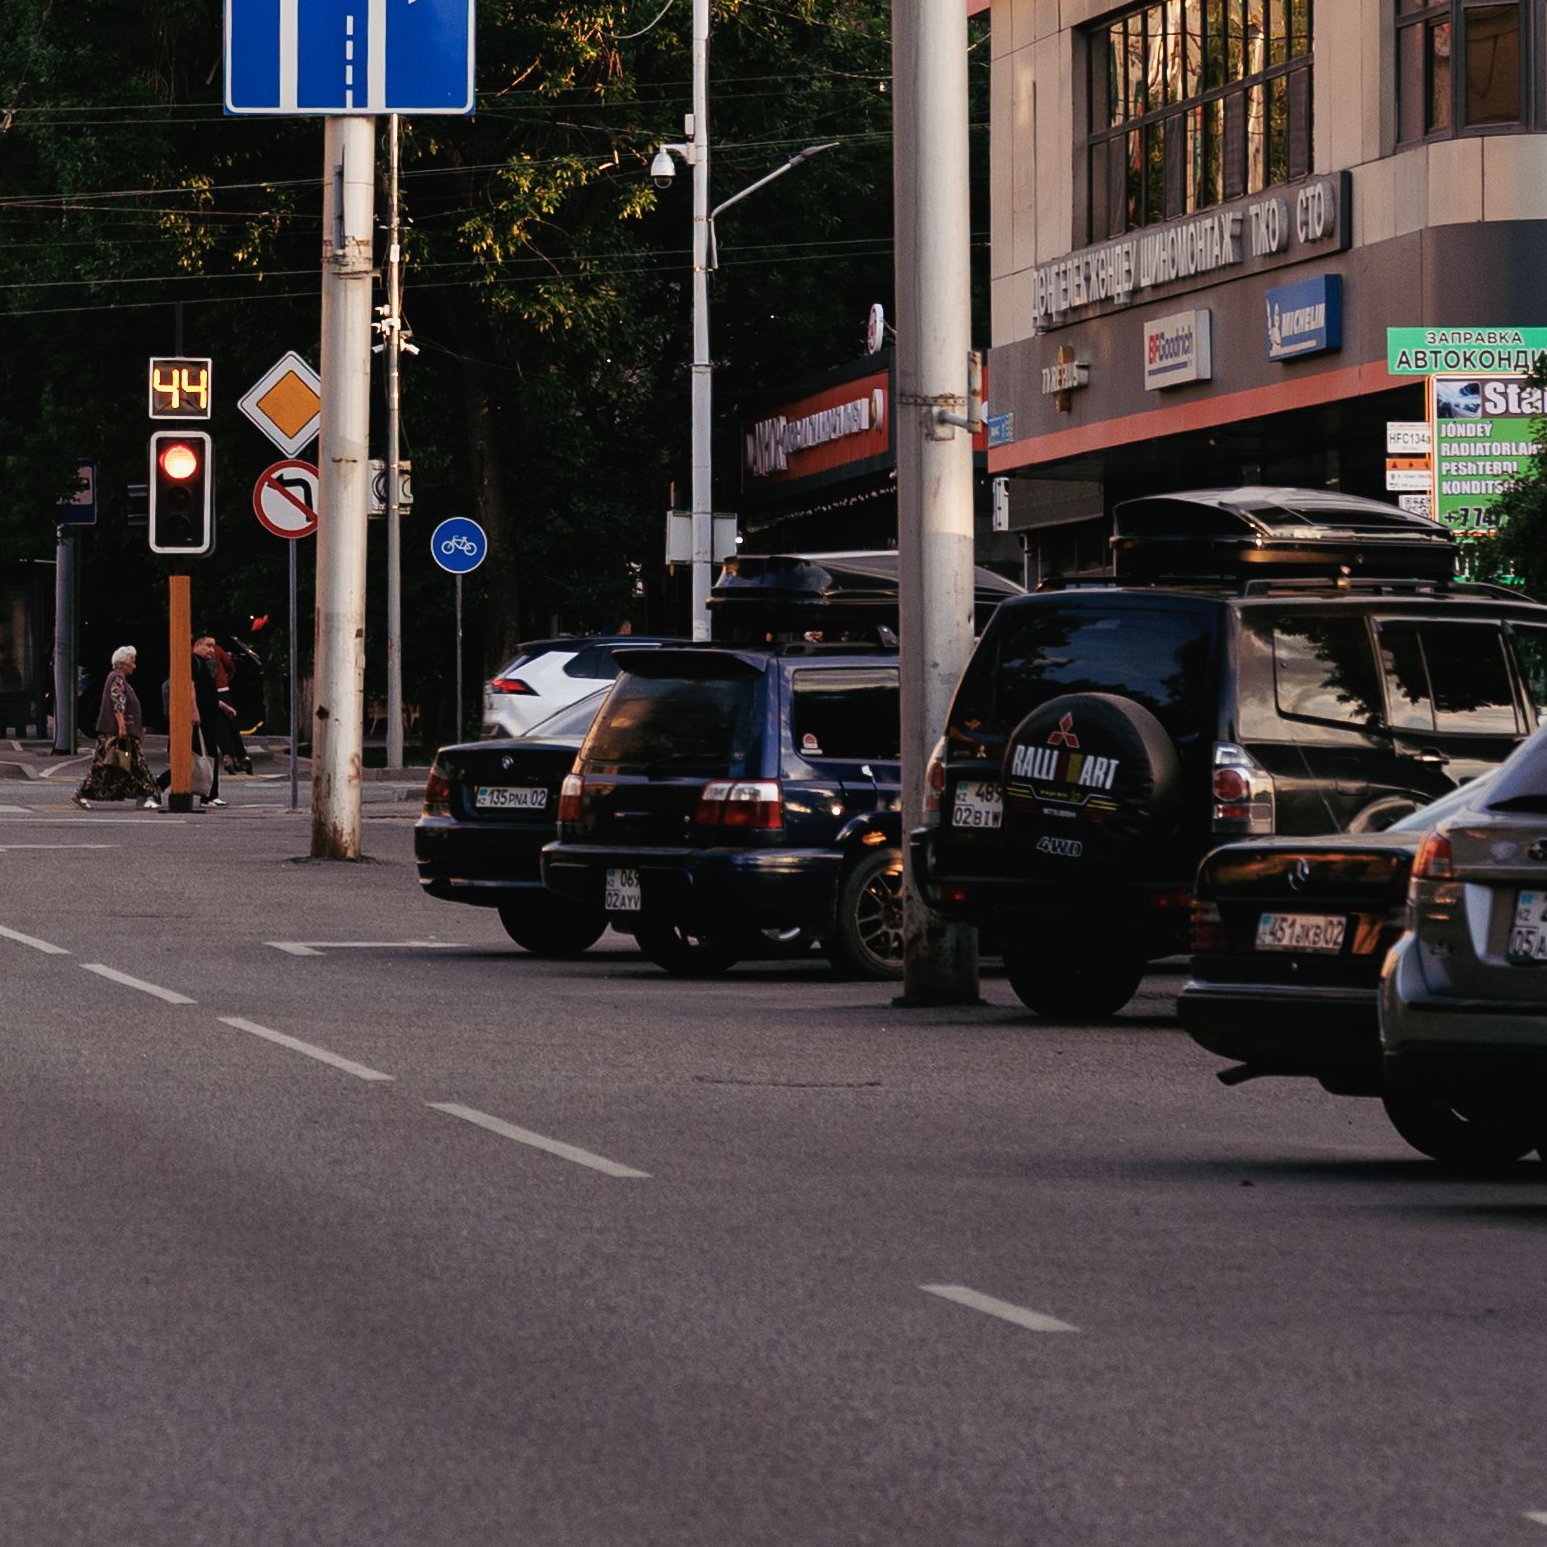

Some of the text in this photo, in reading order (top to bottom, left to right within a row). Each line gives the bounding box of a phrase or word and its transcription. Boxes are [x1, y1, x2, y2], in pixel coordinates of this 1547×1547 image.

[1140, 212, 1234, 287] ШИНОМОНТАЖ
[1297, 182, 1325, 243] СТО
[1281, 302, 1325, 338] MICHELIN
[1148, 325, 1193, 365] BFGoodrich
[1426, 331, 1523, 345] ЗАПРАВКА
[153, 368, 208, 410] 44
[1484, 381, 1547, 415] Sta
[1011, 744, 1119, 790] RALLI ART
[530, 790, 547, 806] 02
[953, 807, 973, 825] 02
[1036, 836, 1083, 857] 4WD
